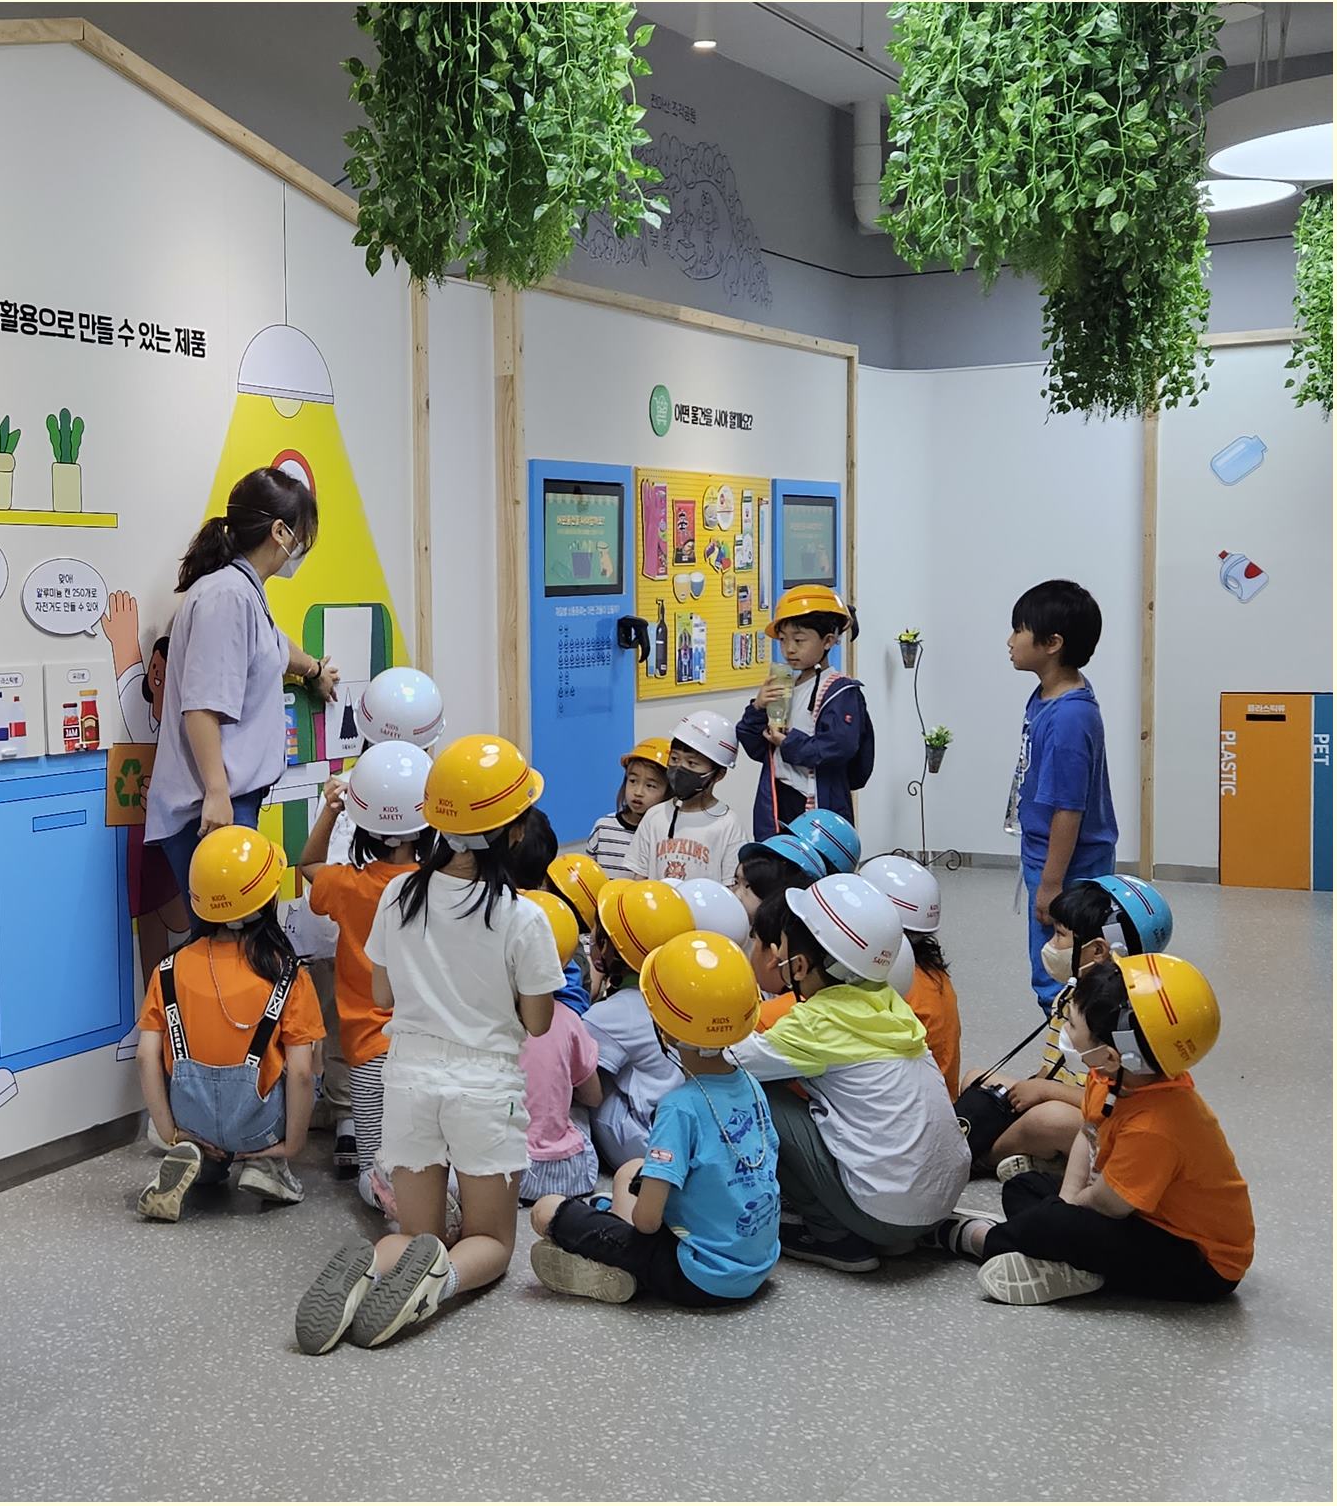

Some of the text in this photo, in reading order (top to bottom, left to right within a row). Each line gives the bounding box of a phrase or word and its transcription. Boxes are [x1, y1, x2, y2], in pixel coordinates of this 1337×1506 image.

[78, 312, 114, 346] 만들
[117, 318, 135, 347] 수
[138, 321, 171, 354] 있는
[174, 326, 208, 359] 제품
[674, 403, 753, 431] 어떤 물건을 사야 할까요?
[36, 588, 98, 599] 알루미늄 캔 250개로
[35, 601, 99, 613] 자전거도 만들 수 있어
[385, 723, 399, 731] KIDS
[65, 728, 78, 737] JAM
[380, 729, 401, 739] SAFETY
[1313, 734, 1330, 766] PET
[1220, 730, 1237, 797] PLASTIC
[439, 798, 453, 807] KIDS
[379, 813, 403, 821] SAFETY
[435, 806, 458, 818] SAFETY
[211, 894, 226, 902] KIDS
[210, 901, 232, 910] SAFETY
[711, 1017, 730, 1025] KIDS
[706, 1025, 733, 1033] SAFETY
[1174, 1040, 1190, 1062] SAFETY
